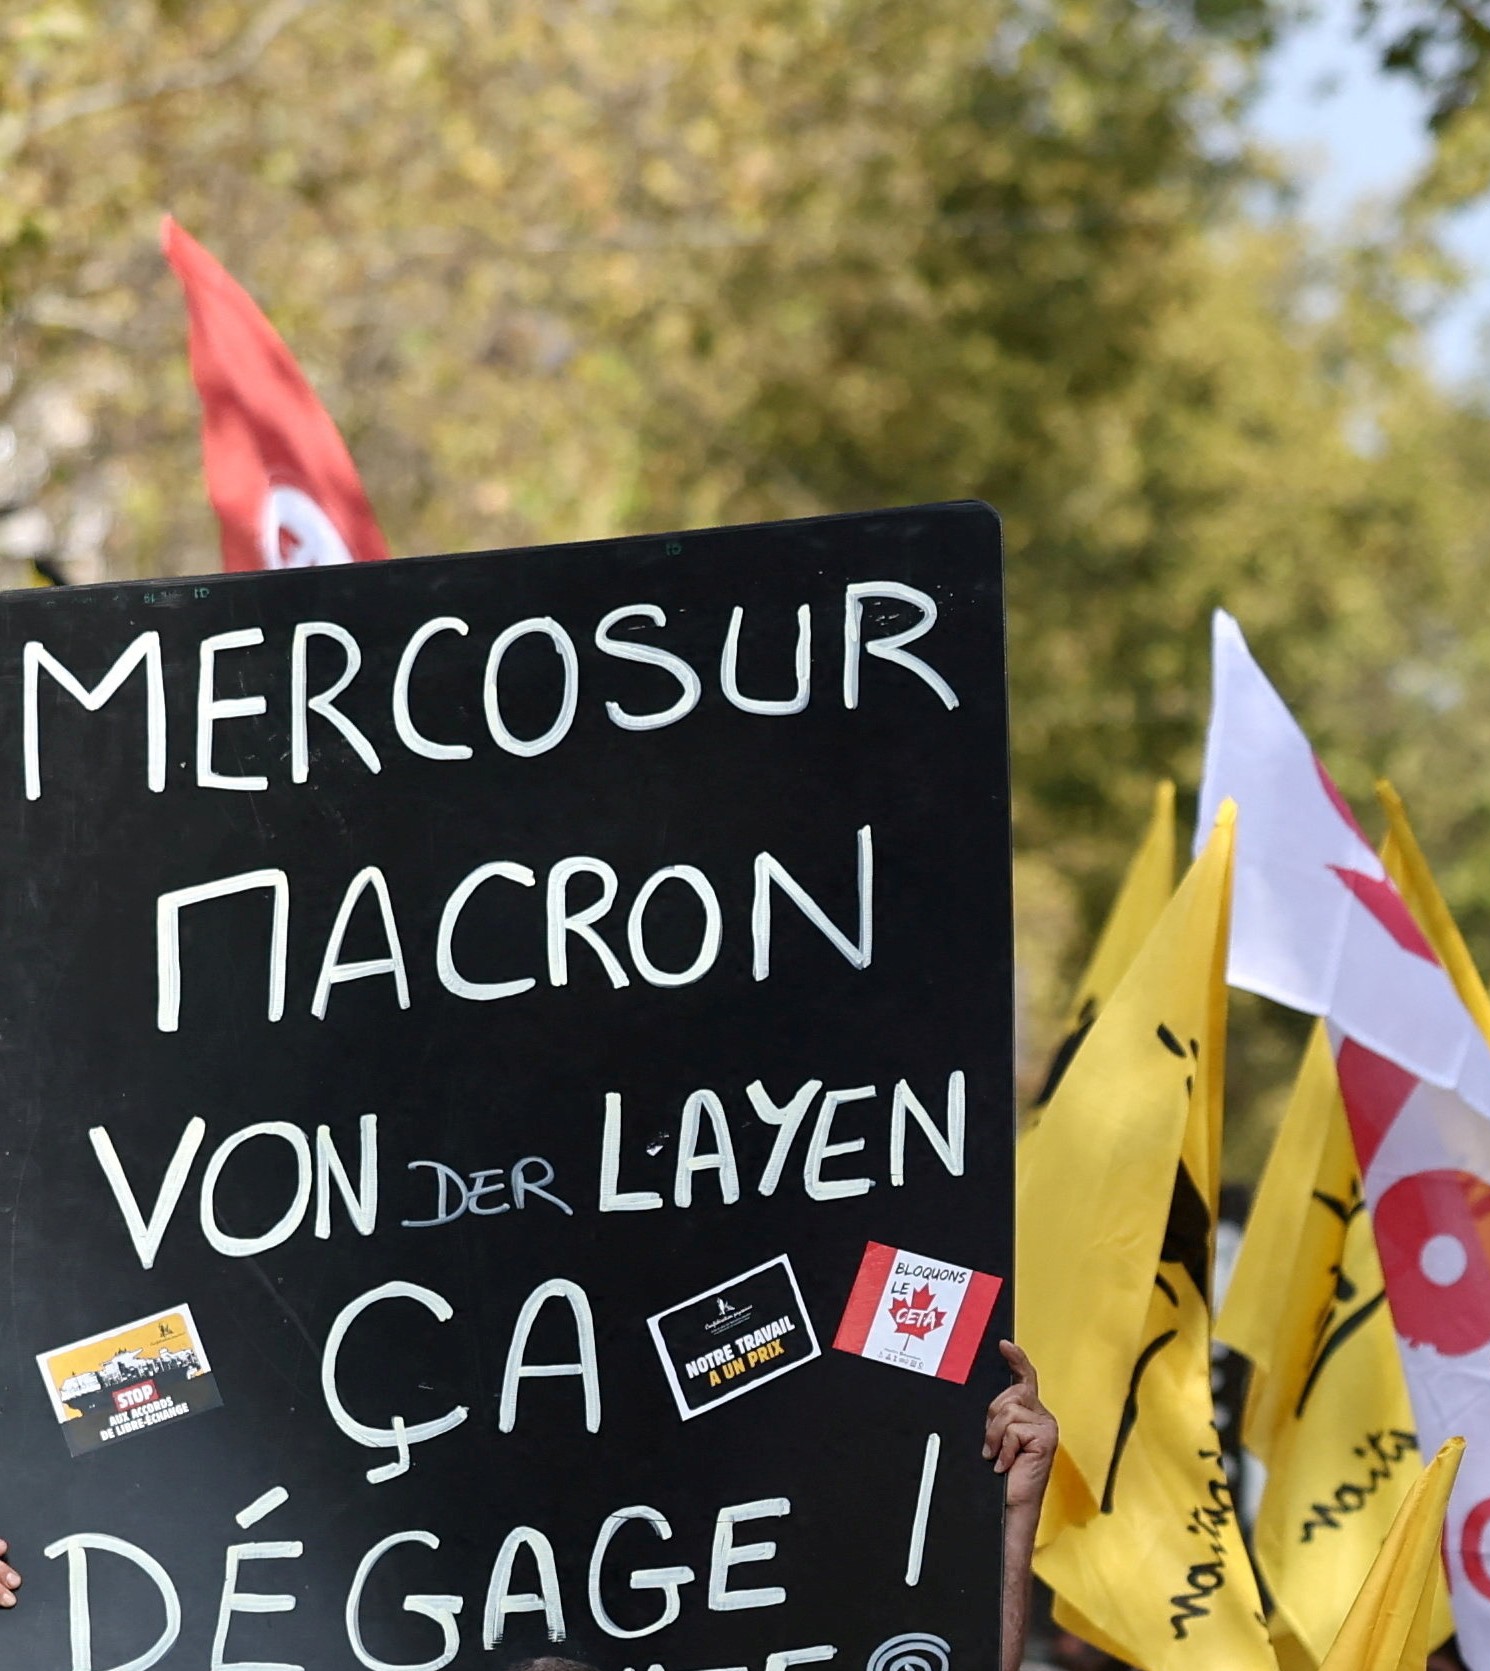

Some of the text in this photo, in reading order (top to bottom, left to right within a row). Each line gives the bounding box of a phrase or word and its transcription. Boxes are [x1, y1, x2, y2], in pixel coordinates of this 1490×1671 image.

[23, 581, 959, 801] MERCOSUR
[89, 1070, 965, 1269] VON DER LAYEN
[890, 1281, 911, 1295] LE
[895, 1262, 967, 1284] BLOQUONS
[896, 1308, 937, 1330] CETA
[685, 1344, 735, 1379] NOTRE
[735, 1315, 796, 1355] TRAVAIL
[709, 1339, 785, 1387] A UN PRIX
[116, 1383, 154, 1409] STOP
[321, 1278, 601, 1484] ÇA
[109, 1396, 174, 1427] AUX ACCORDS
[100, 1427, 116, 1441] DE
